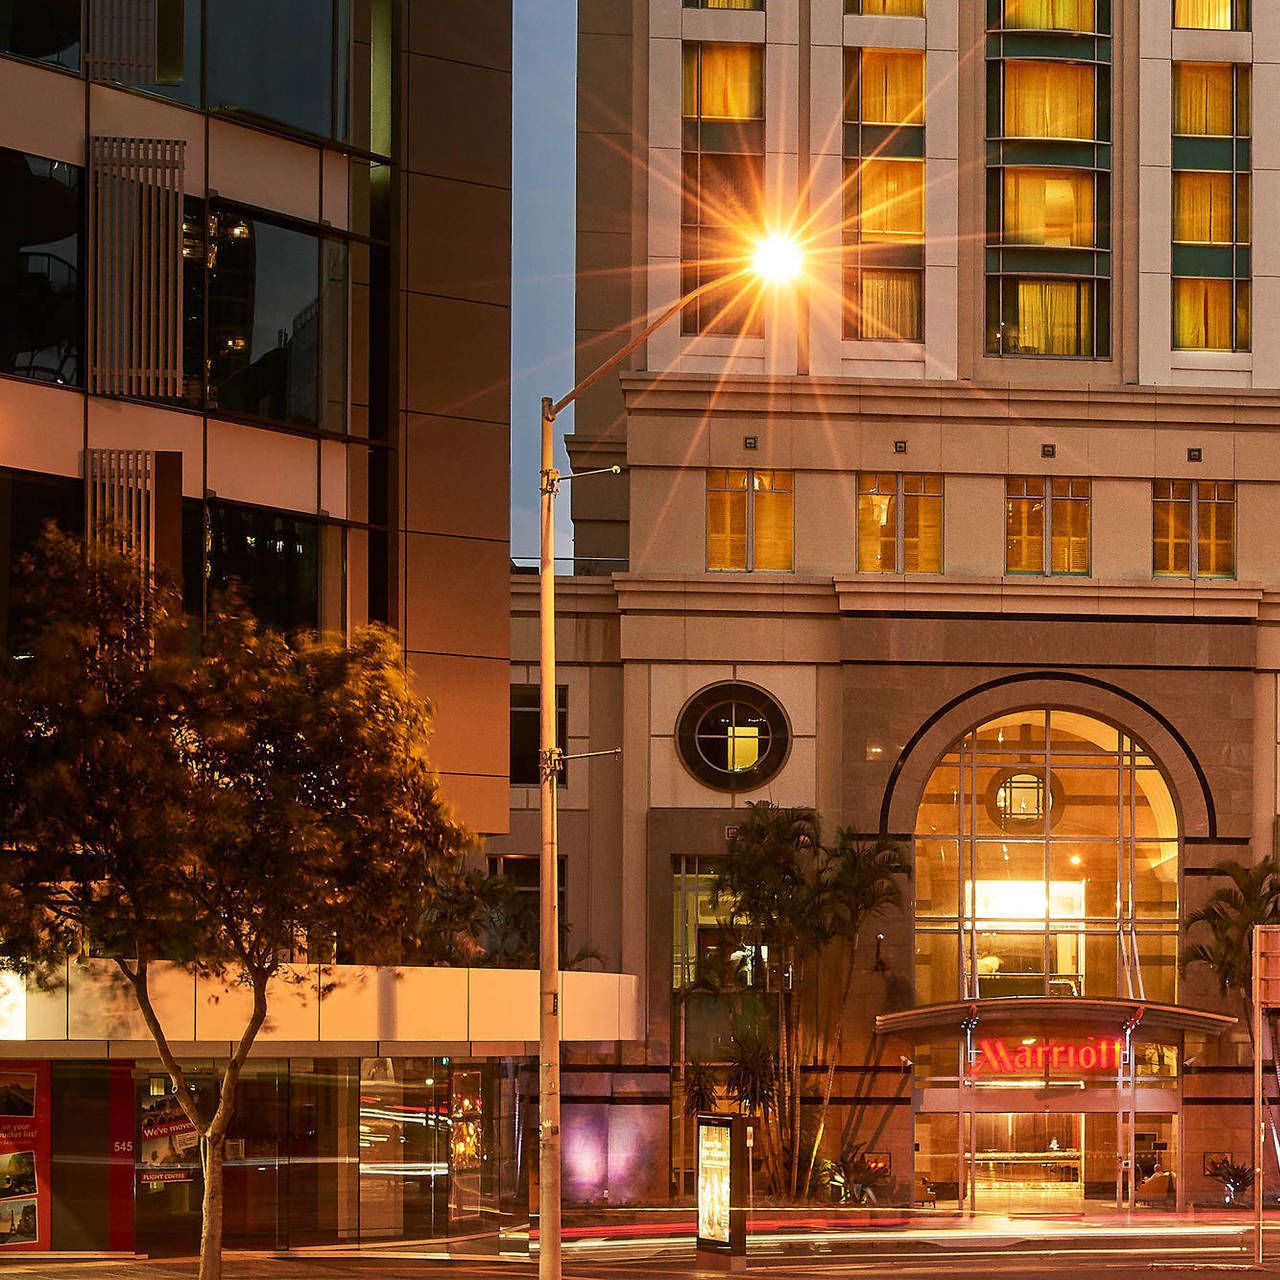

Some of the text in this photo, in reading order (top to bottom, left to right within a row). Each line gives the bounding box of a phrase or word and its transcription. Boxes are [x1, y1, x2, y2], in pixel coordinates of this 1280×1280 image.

[968, 1038, 1124, 1074] Marriott
[143, 1122, 194, 1138] We've move
[114, 1141, 133, 1152] 545
